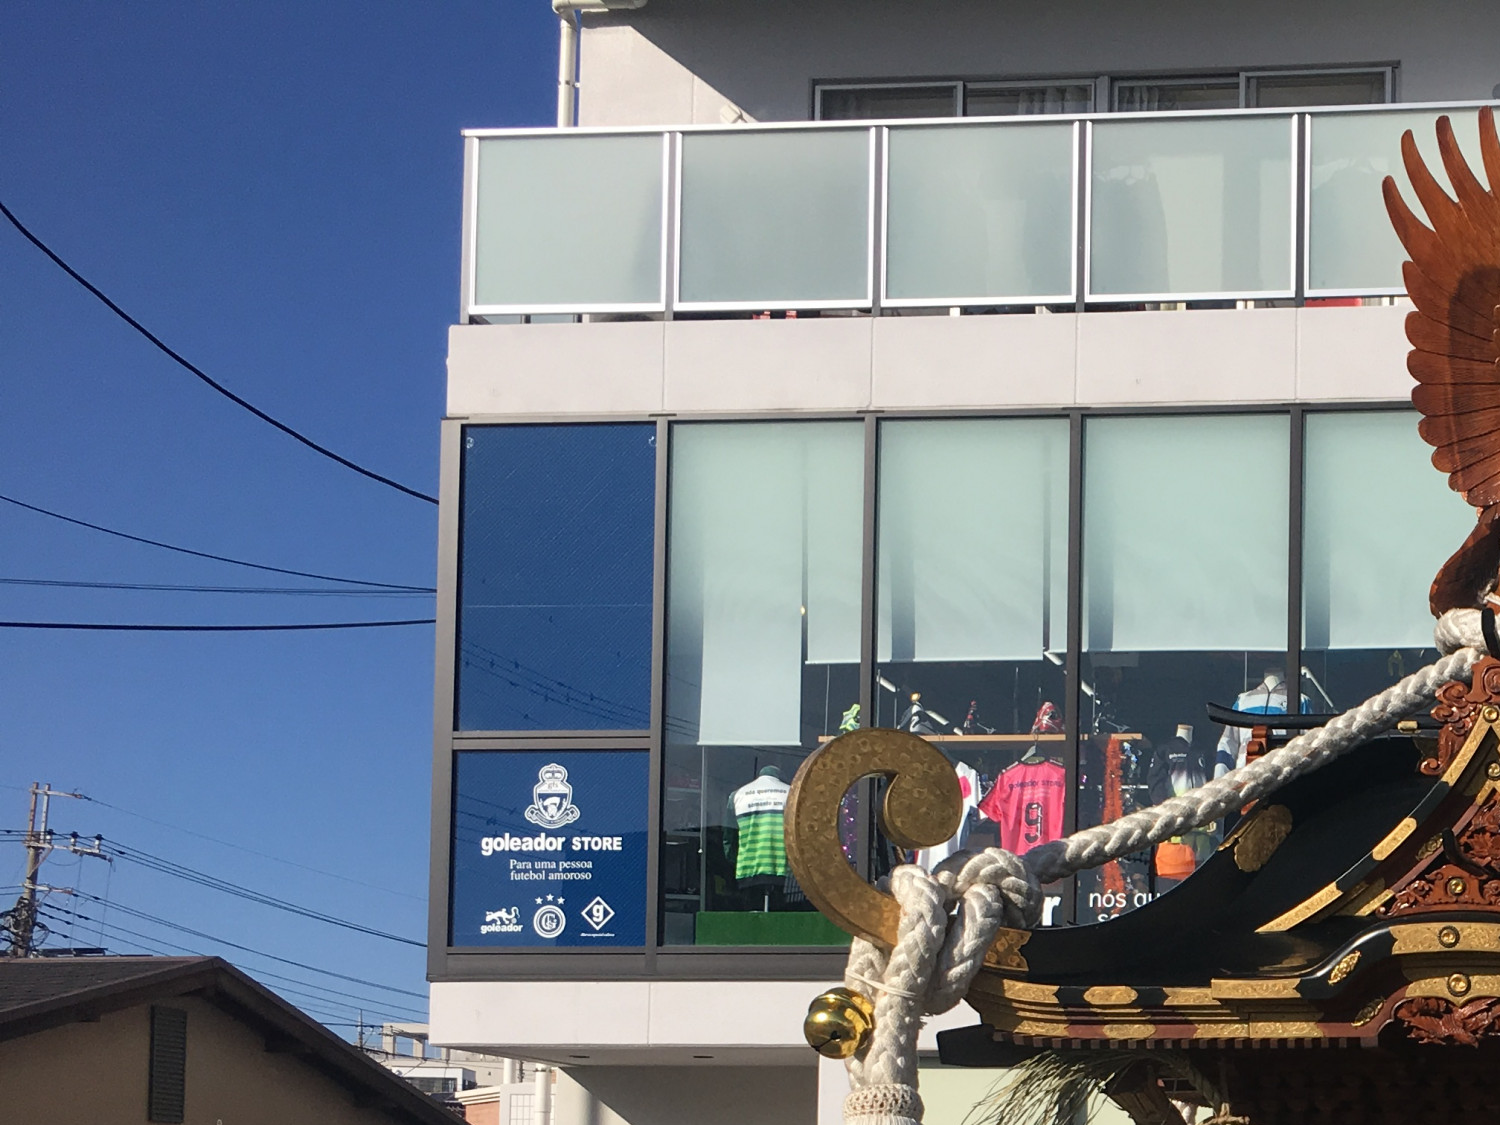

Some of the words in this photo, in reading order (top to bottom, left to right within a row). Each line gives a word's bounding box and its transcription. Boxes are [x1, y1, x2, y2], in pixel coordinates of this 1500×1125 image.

[1025, 803, 1042, 843] 9
[481, 833, 565, 856] goleador
[572, 837, 623, 851] STORE
[509, 859, 531, 869] Para
[535, 861, 556, 869] uma
[559, 861, 593, 871] pessoa
[510, 871, 545, 881] futebol
[549, 873, 592, 881] amoroso
[1089, 889, 1126, 908] nós
[481, 923, 523, 934] goleador
